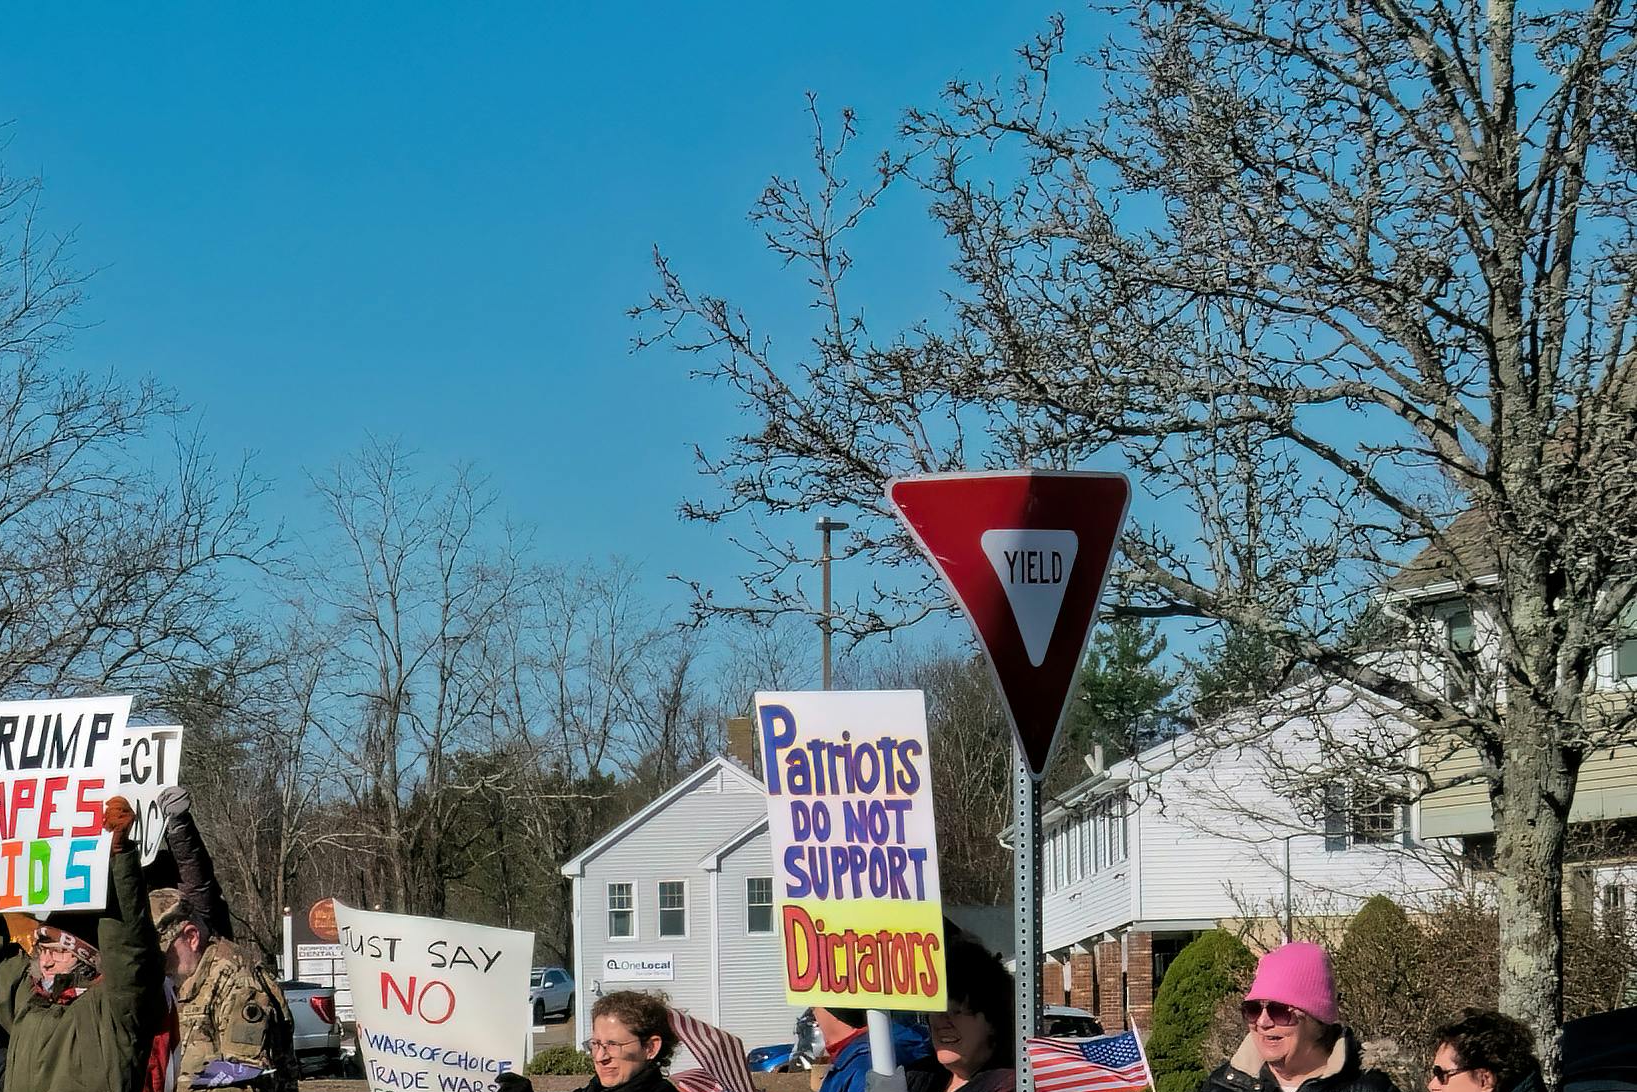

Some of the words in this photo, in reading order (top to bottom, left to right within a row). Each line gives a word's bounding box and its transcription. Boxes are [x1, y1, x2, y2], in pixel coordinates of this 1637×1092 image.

[1003, 550, 1063, 584] YIELD
[759, 704, 923, 796] Patriots
[790, 799, 831, 843] DO
[843, 799, 912, 846] NOT
[784, 845, 927, 901] SUPPORT
[342, 926, 402, 963] JUST
[427, 941, 502, 973] SAY
[782, 904, 940, 998] Dictators
[380, 971, 456, 1025] NO
[364, 1028, 417, 1059] WARS
[420, 1046, 443, 1062] OF
[442, 1050, 513, 1075] CHOICE
[369, 1059, 428, 1090] TRADE
